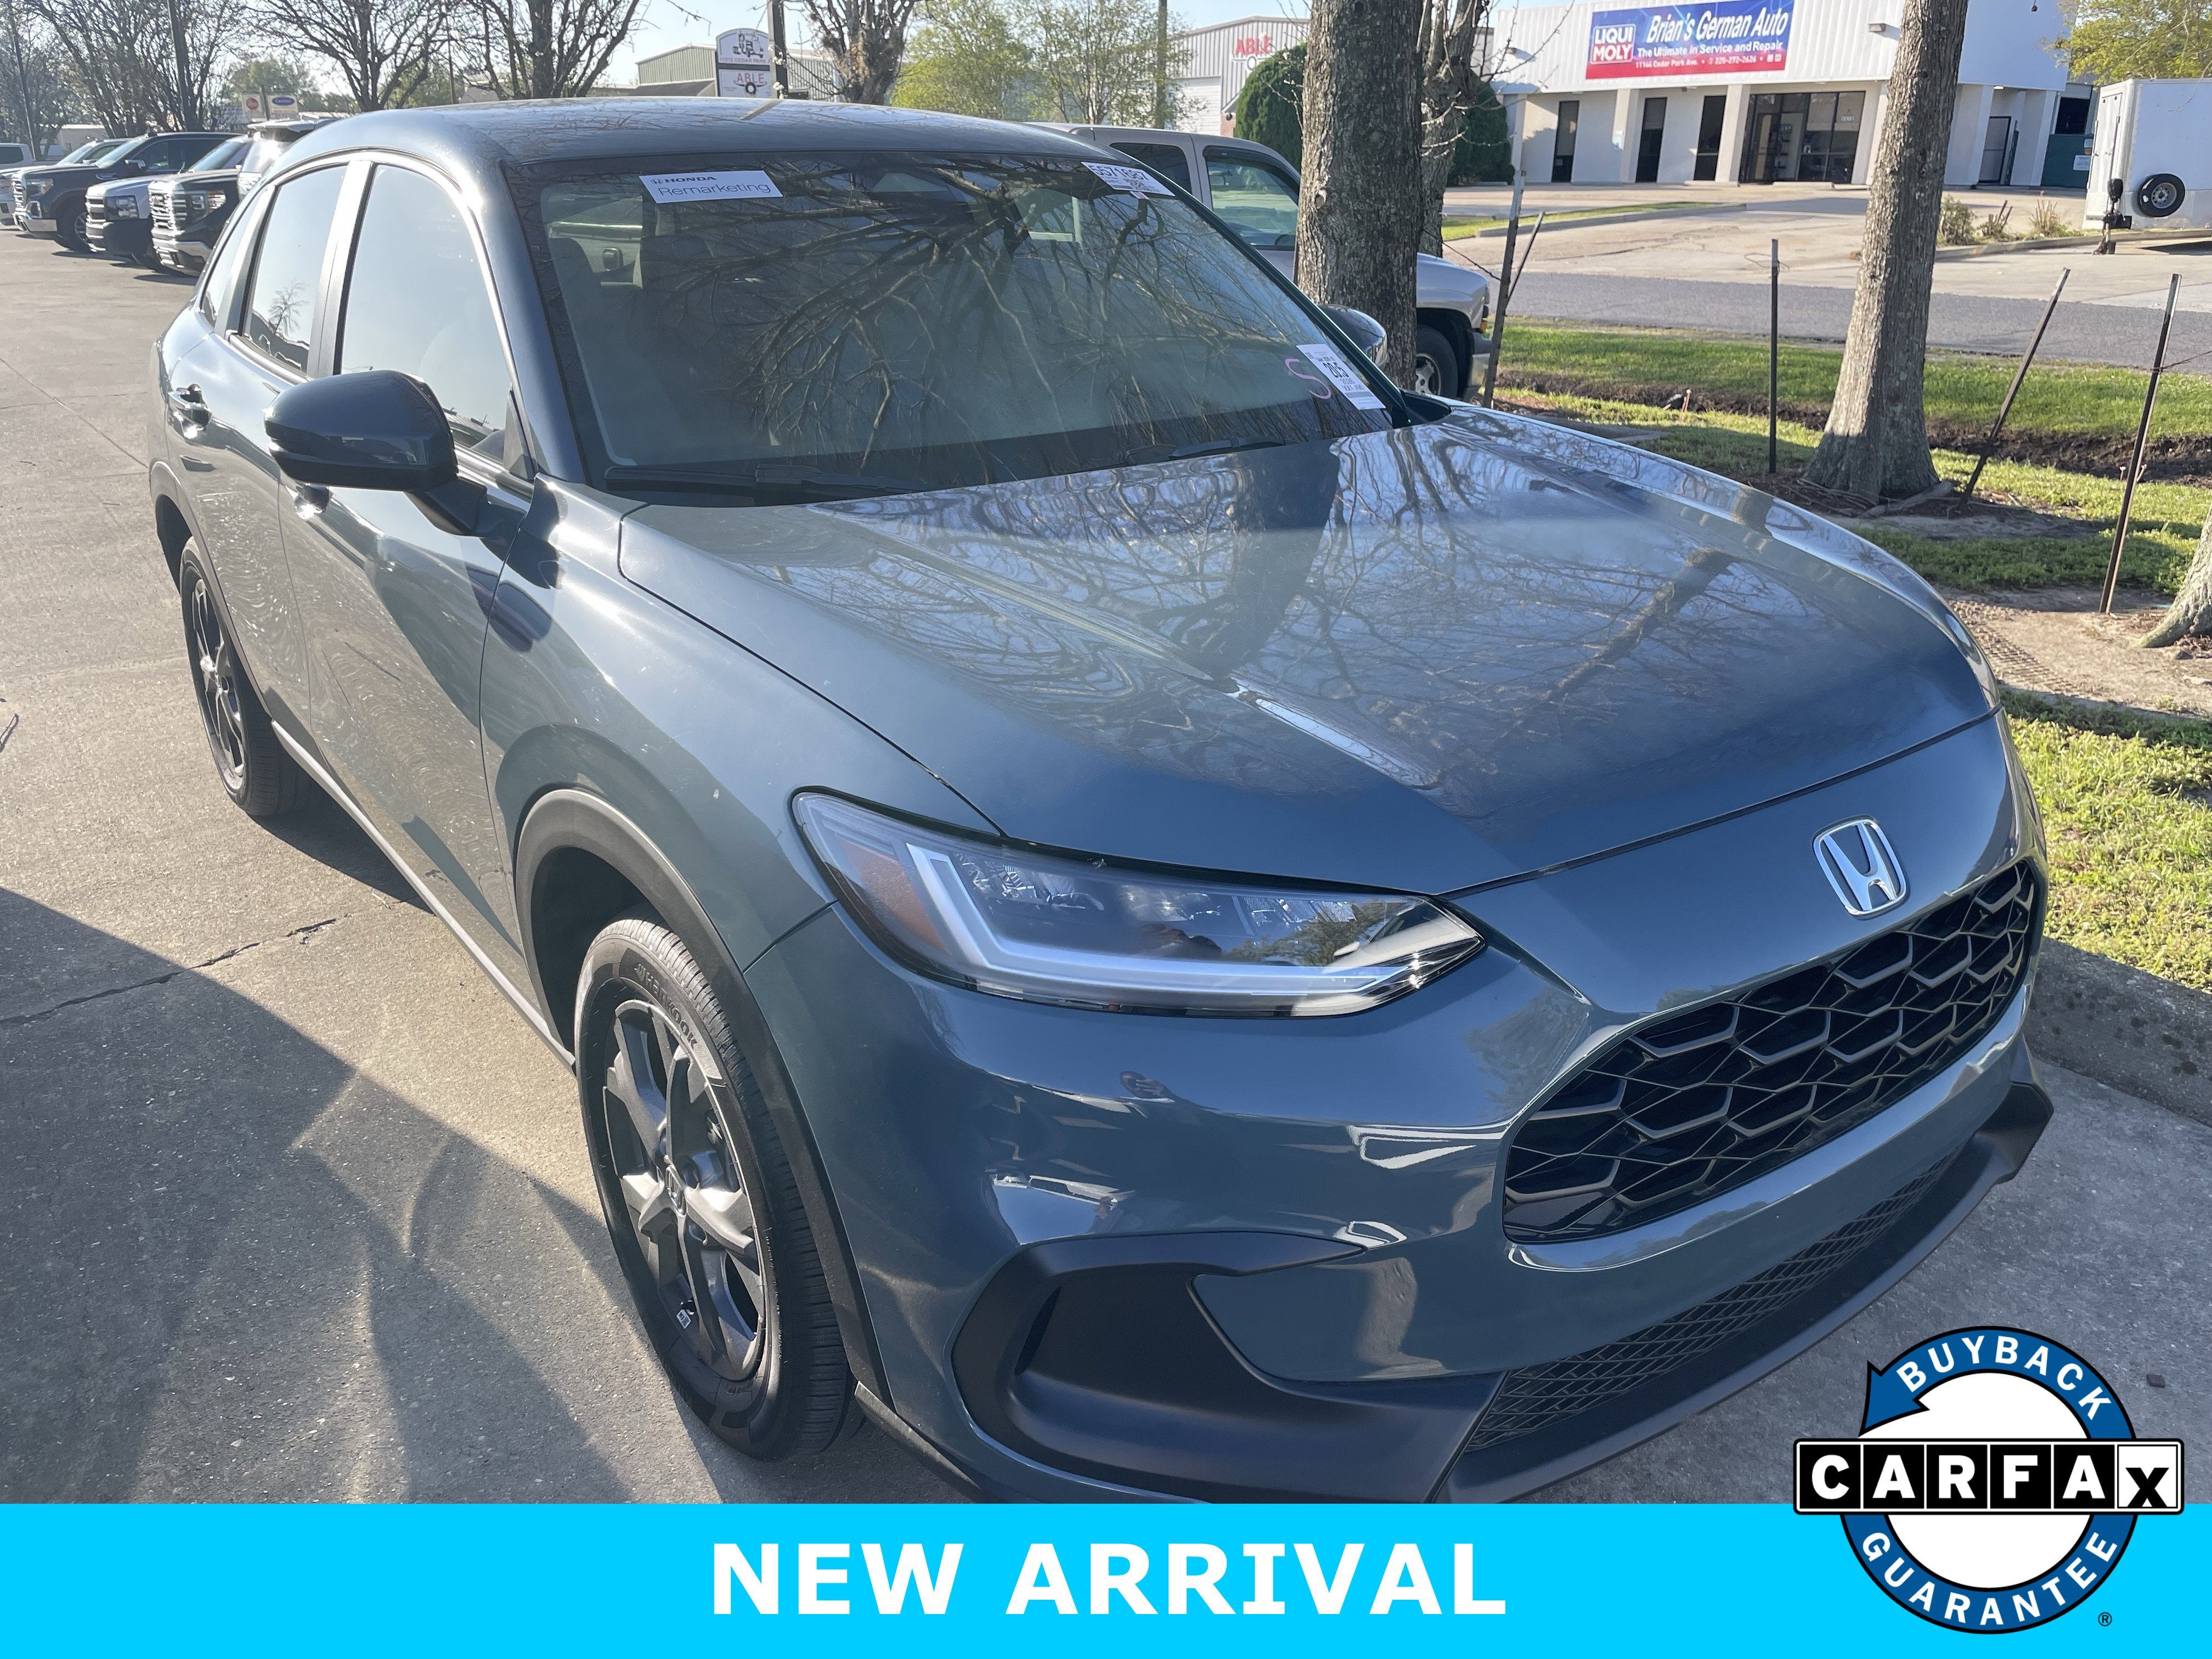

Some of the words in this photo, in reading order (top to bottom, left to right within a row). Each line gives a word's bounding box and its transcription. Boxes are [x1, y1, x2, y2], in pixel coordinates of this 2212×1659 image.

[1646, 12, 1695, 43] Brian's
[1696, 10, 1752, 41] German
[1750, 7, 1788, 37] Auto
[1594, 26, 1633, 44] LIQUI
[1235, 35, 1272, 56] ABLE
[1593, 43, 1633, 61] MOLY
[1638, 47, 1653, 58] The
[1654, 46, 1688, 57] Ultimate
[1700, 43, 1733, 54] Service
[1735, 42, 1752, 52] and
[1753, 40, 1783, 53] Repair
[737, 72, 764, 83] ABLE
[1088, 165, 1149, 180] 5571687
[658, 183, 770, 196] Remarketing
